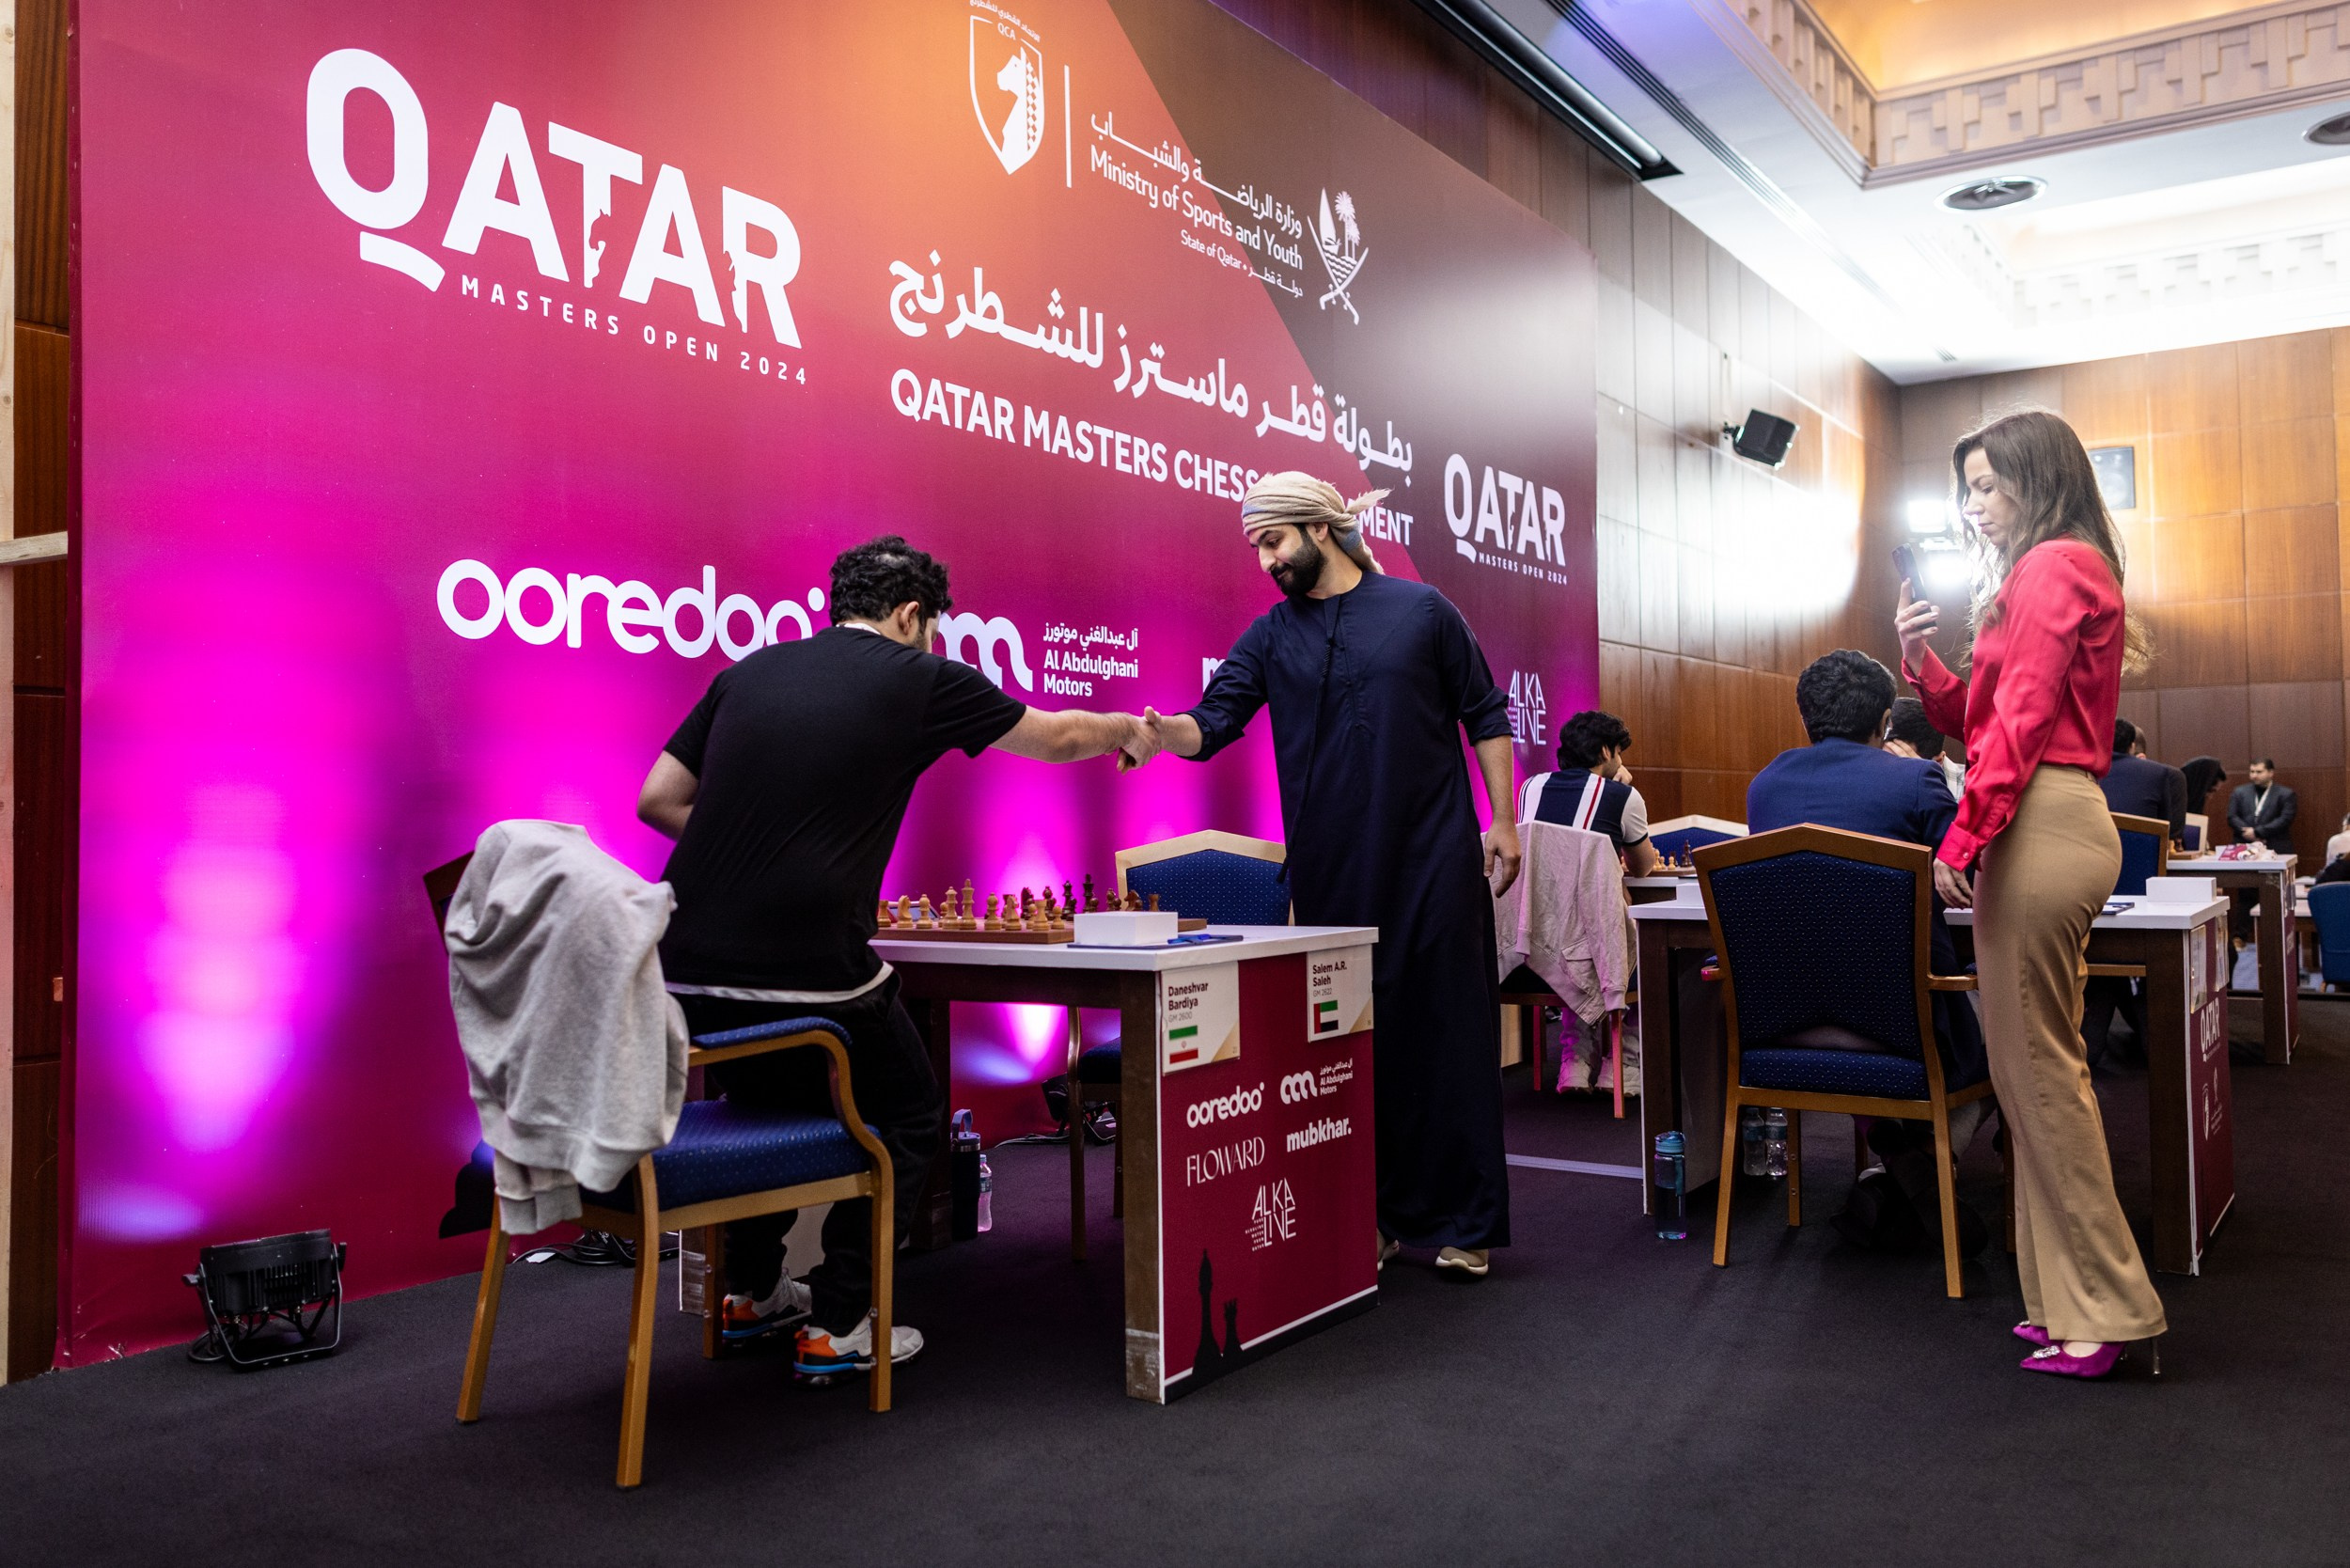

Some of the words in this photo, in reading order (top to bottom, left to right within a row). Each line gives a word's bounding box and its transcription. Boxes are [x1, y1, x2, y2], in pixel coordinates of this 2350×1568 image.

[997, 23, 1016, 40] QCA
[1090, 111, 1189, 182] والشباب
[306, 48, 802, 349] QATAR
[1090, 144, 1158, 209] Ministry
[1162, 184, 1180, 211] of
[1182, 191, 1232, 237] Sports
[1235, 226, 1261, 250] and
[1263, 229, 1303, 270] Youth
[1193, 158, 1272, 220] الرياضة
[1276, 202, 1303, 239] وزارة
[1181, 229, 1205, 254] State
[1206, 243, 1216, 258] of
[1217, 246, 1242, 270] Qatar
[462, 274, 619, 335] MASTERS
[643, 325, 718, 362] OPEN
[740, 352, 806, 384] 2024
[888, 249, 1104, 368] للشطرنج
[1113, 323, 1248, 418] ماسترز
[890, 368, 1016, 444] QATAR
[1024, 405, 1167, 482] MASTERS
[1255, 383, 1326, 442] قطر
[1333, 393, 1413, 488] بطولة
[1444, 453, 1566, 567] QATAR
[1479, 552, 1518, 572] MASTERS
[1522, 564, 1543, 579] OPEN
[1547, 571, 1568, 586] 2024
[436, 558, 825, 662] ooredoo
[1043, 622, 1078, 644] موتورز
[1043, 649, 1059, 670] Al
[1061, 651, 1138, 681] Abdulghani
[1043, 673, 1092, 697] Motors
[1508, 669, 1546, 710] ALKA
[1312, 964, 1333, 974] Salem
[1335, 961, 1347, 971] A.R.
[1312, 975, 1331, 986] Saleh
[1168, 982, 1209, 996] Daneshvar
[1168, 997, 1198, 1011] Bardiya
[1320, 1086, 1337, 1096] Motors
[1326, 1071, 1354, 1084] Abdulghani
[1186, 1082, 1264, 1128] ooredoo
[1287, 1117, 1352, 1152] mubkhar.
[1187, 1137, 1265, 1187] FLOWARD
[1251, 1177, 1295, 1220] ALKA
